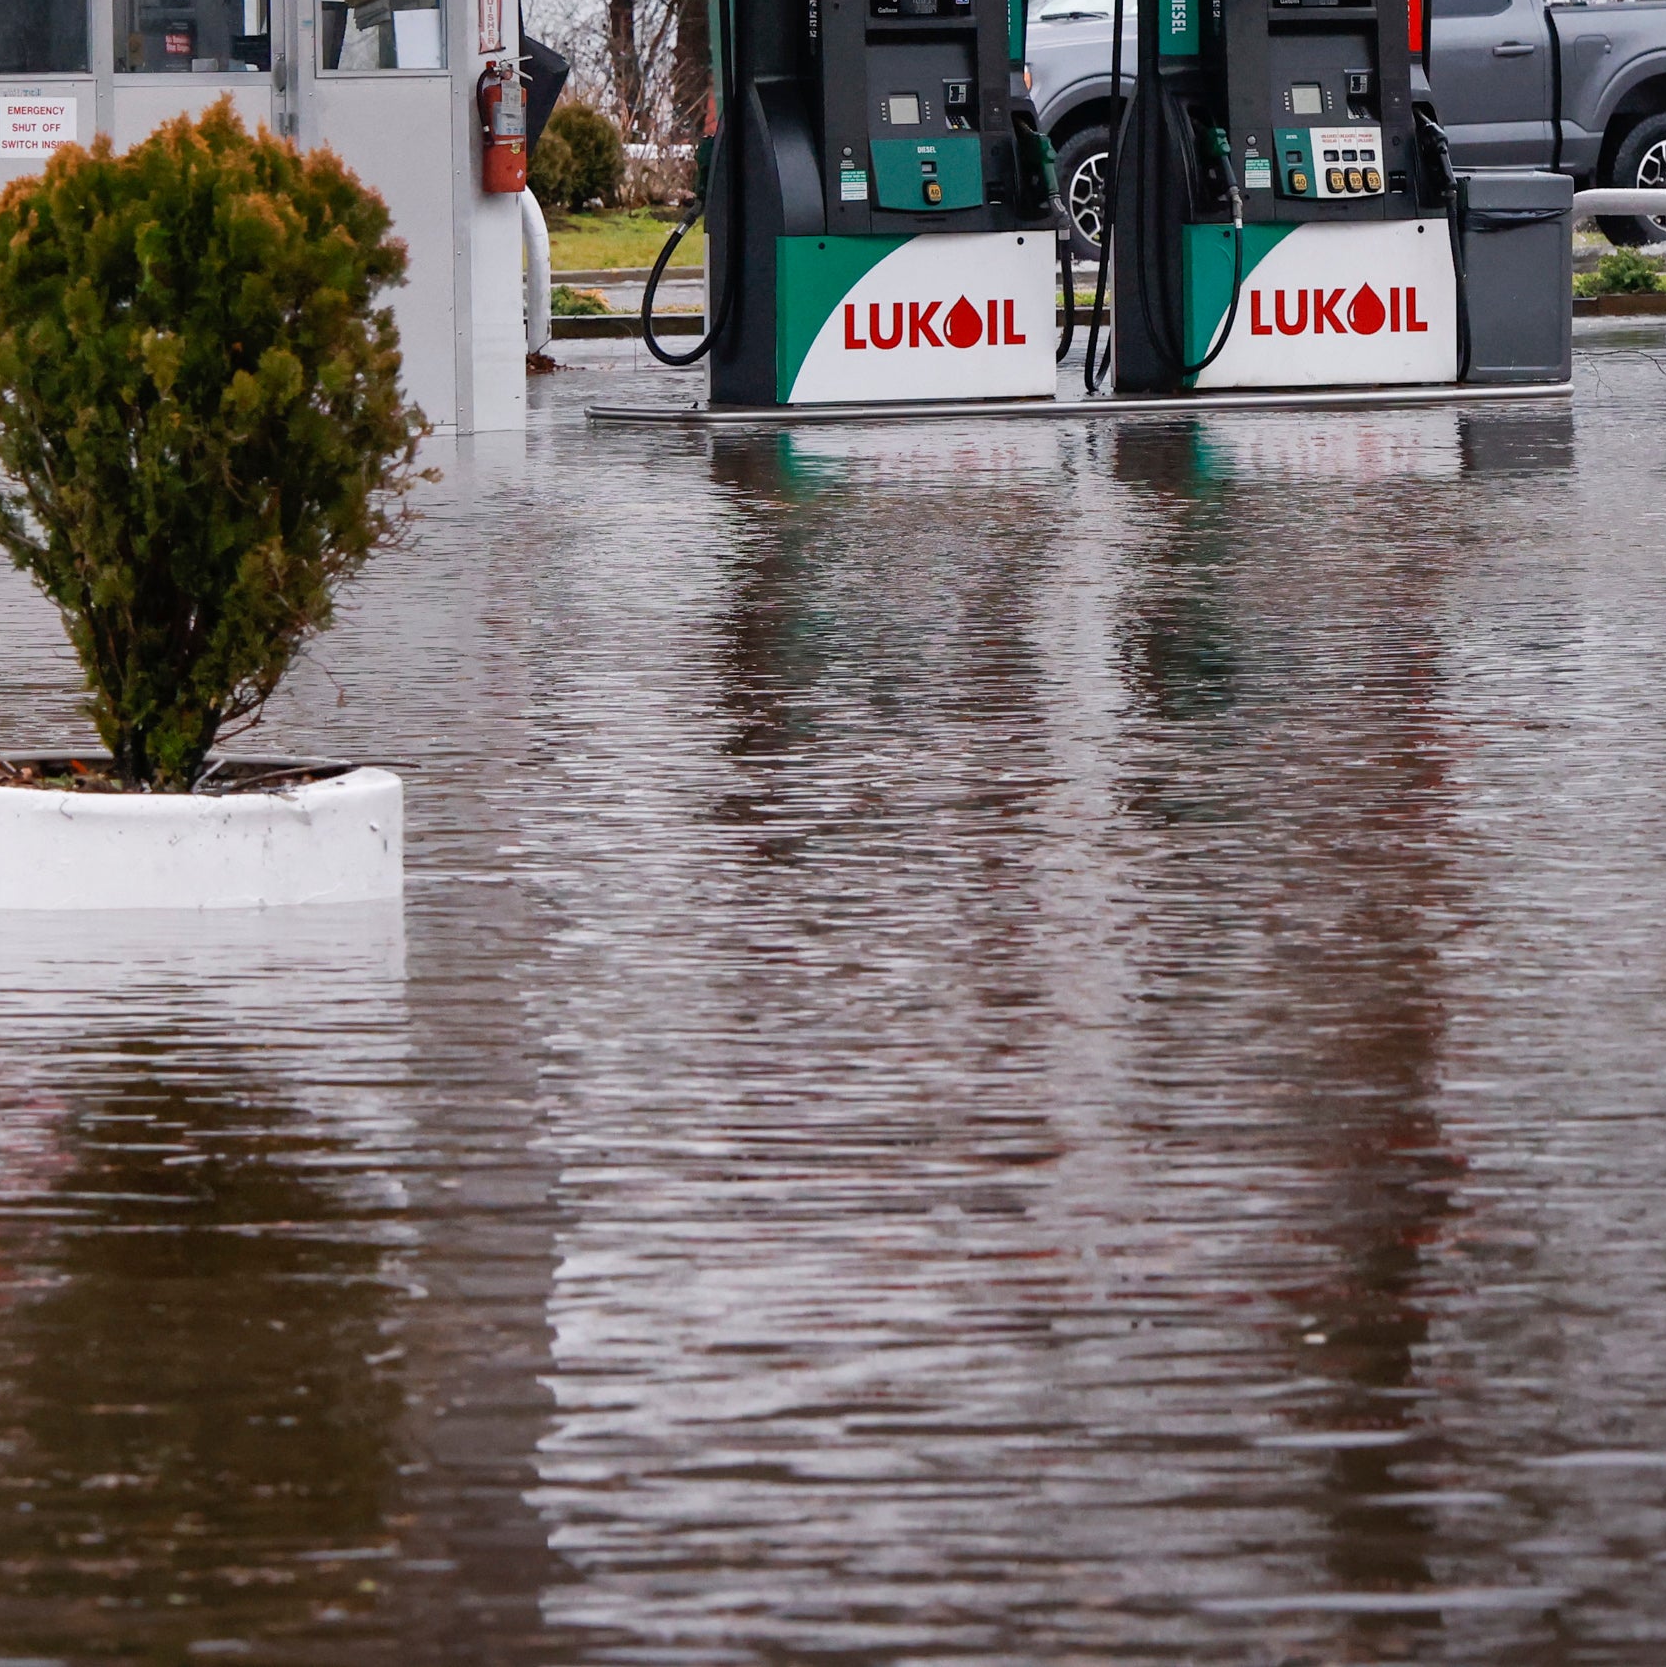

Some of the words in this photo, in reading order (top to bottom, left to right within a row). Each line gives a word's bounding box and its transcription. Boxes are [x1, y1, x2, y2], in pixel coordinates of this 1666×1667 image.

[7, 106, 65, 116] EMERGENCY
[12, 123, 37, 132] SHUT
[42, 123, 61, 132] OFF
[1, 140, 38, 149] SWITCH
[917, 146, 937, 154] DIESEL
[1369, 176, 1378, 184] 93
[1251, 281, 1428, 337] LUKOIL
[843, 294, 1026, 350] LUKOIL
